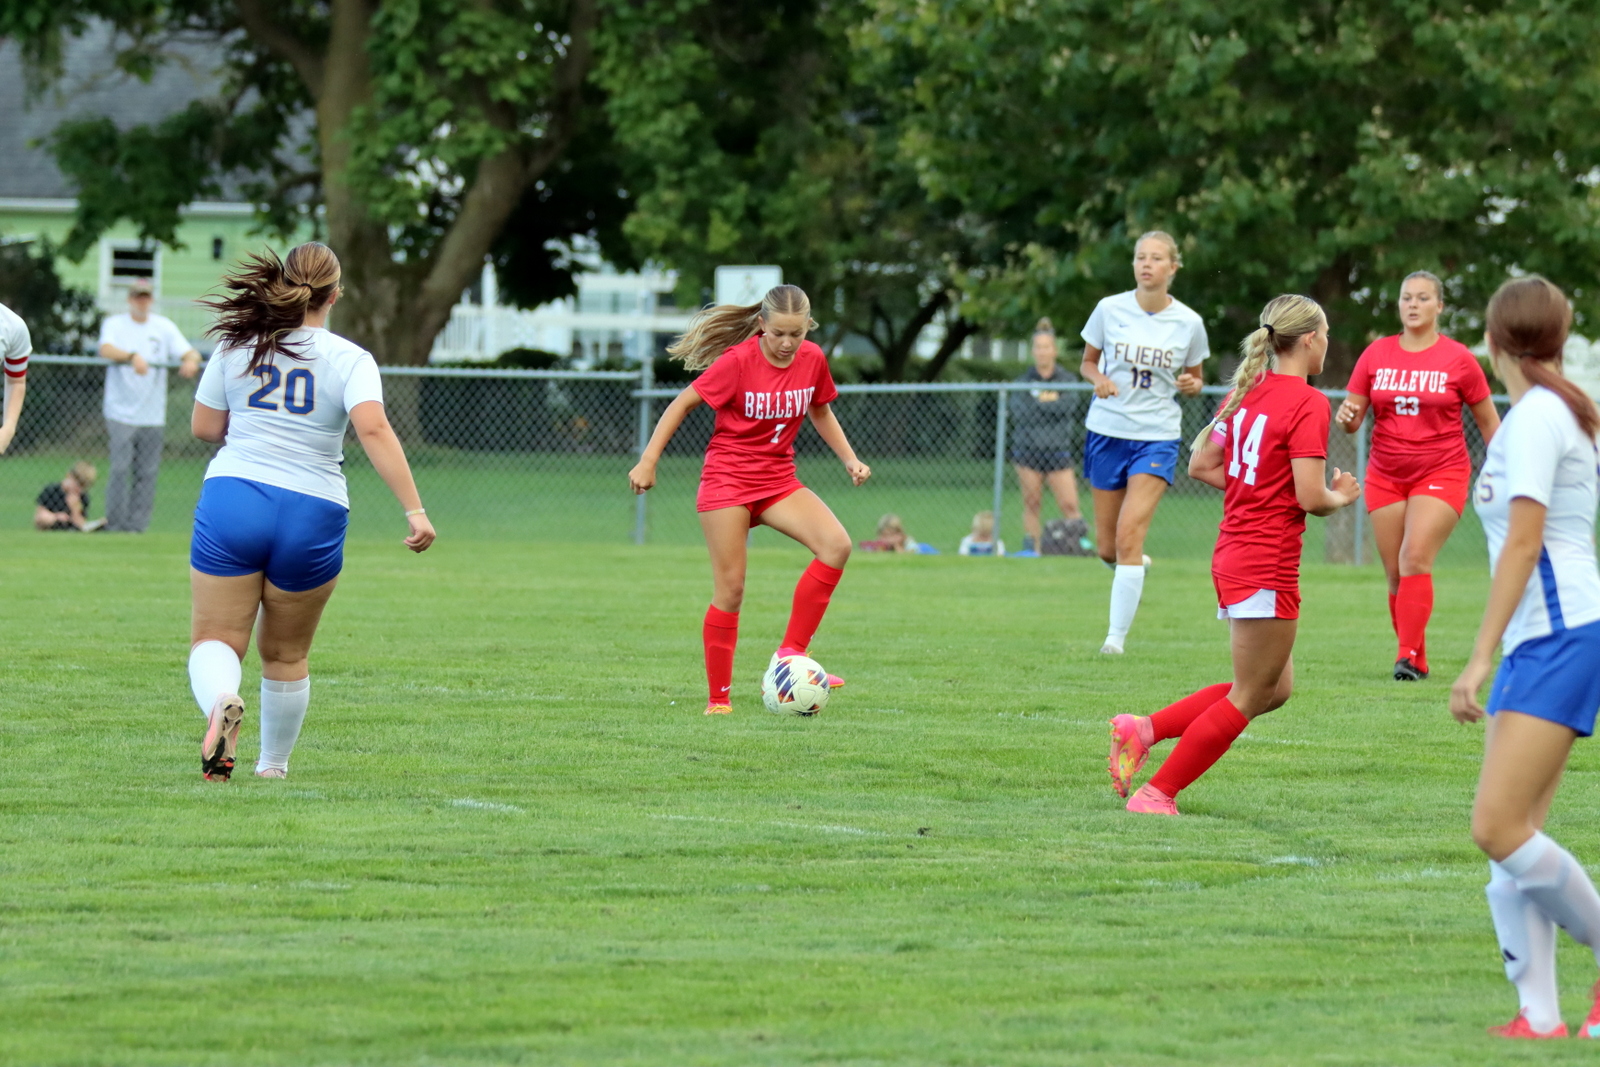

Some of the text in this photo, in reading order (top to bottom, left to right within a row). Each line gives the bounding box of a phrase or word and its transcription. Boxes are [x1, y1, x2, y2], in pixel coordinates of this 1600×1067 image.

[1114, 342, 1174, 369] FLIERS
[247, 363, 315, 416] 20
[1131, 366, 1152, 390] 18
[1372, 368, 1448, 394] BELLEVUE
[1394, 395, 1420, 416] 23
[770, 423, 787, 444] 7
[1228, 407, 1268, 486] 14
